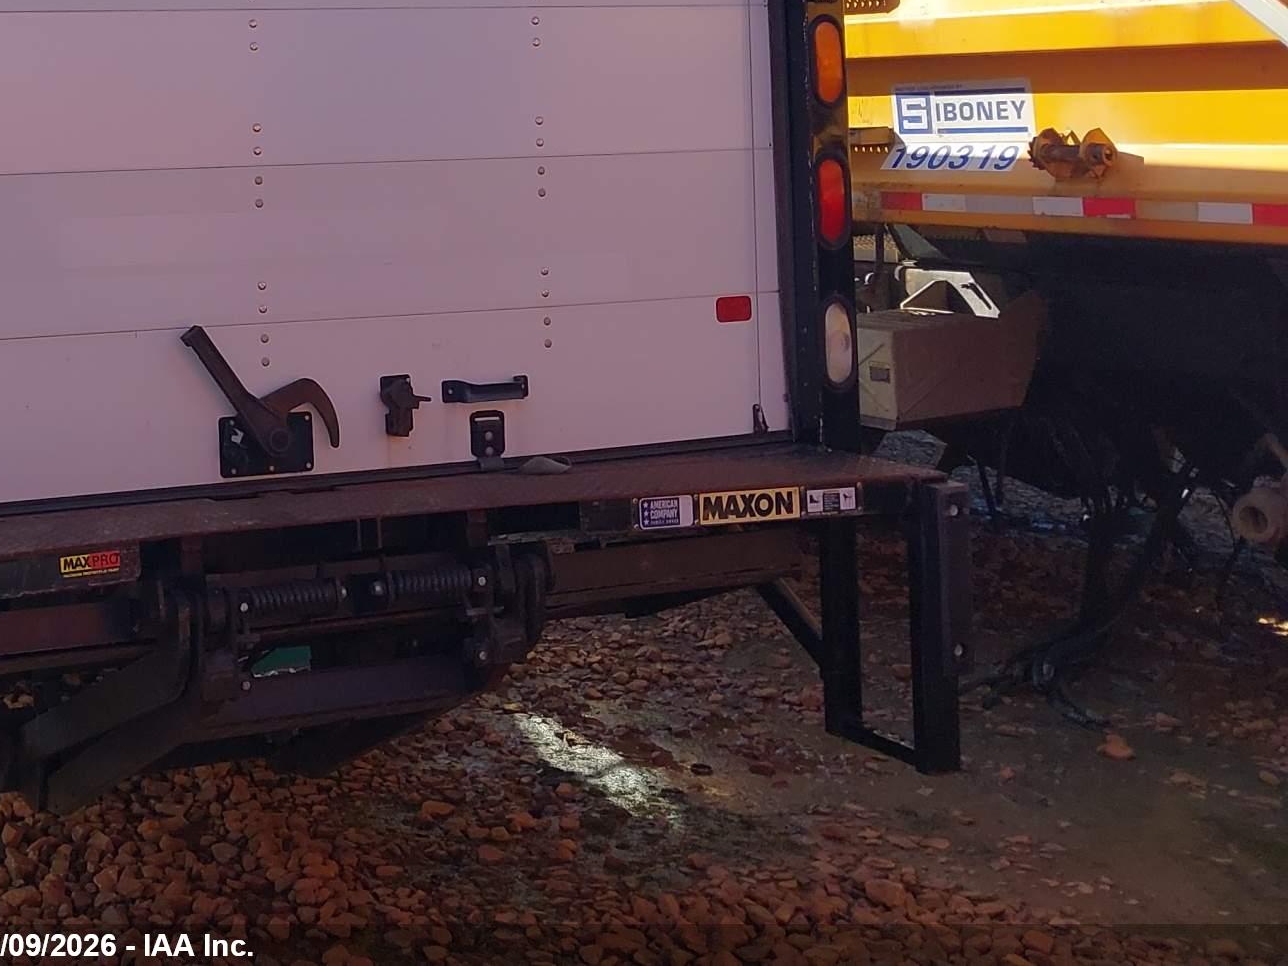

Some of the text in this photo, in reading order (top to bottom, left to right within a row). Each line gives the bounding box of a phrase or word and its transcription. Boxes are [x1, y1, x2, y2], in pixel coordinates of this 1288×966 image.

[891, 144, 1020, 171] 190319
[702, 490, 794, 521] MAXON
[63, 553, 119, 571] MAXPRO
